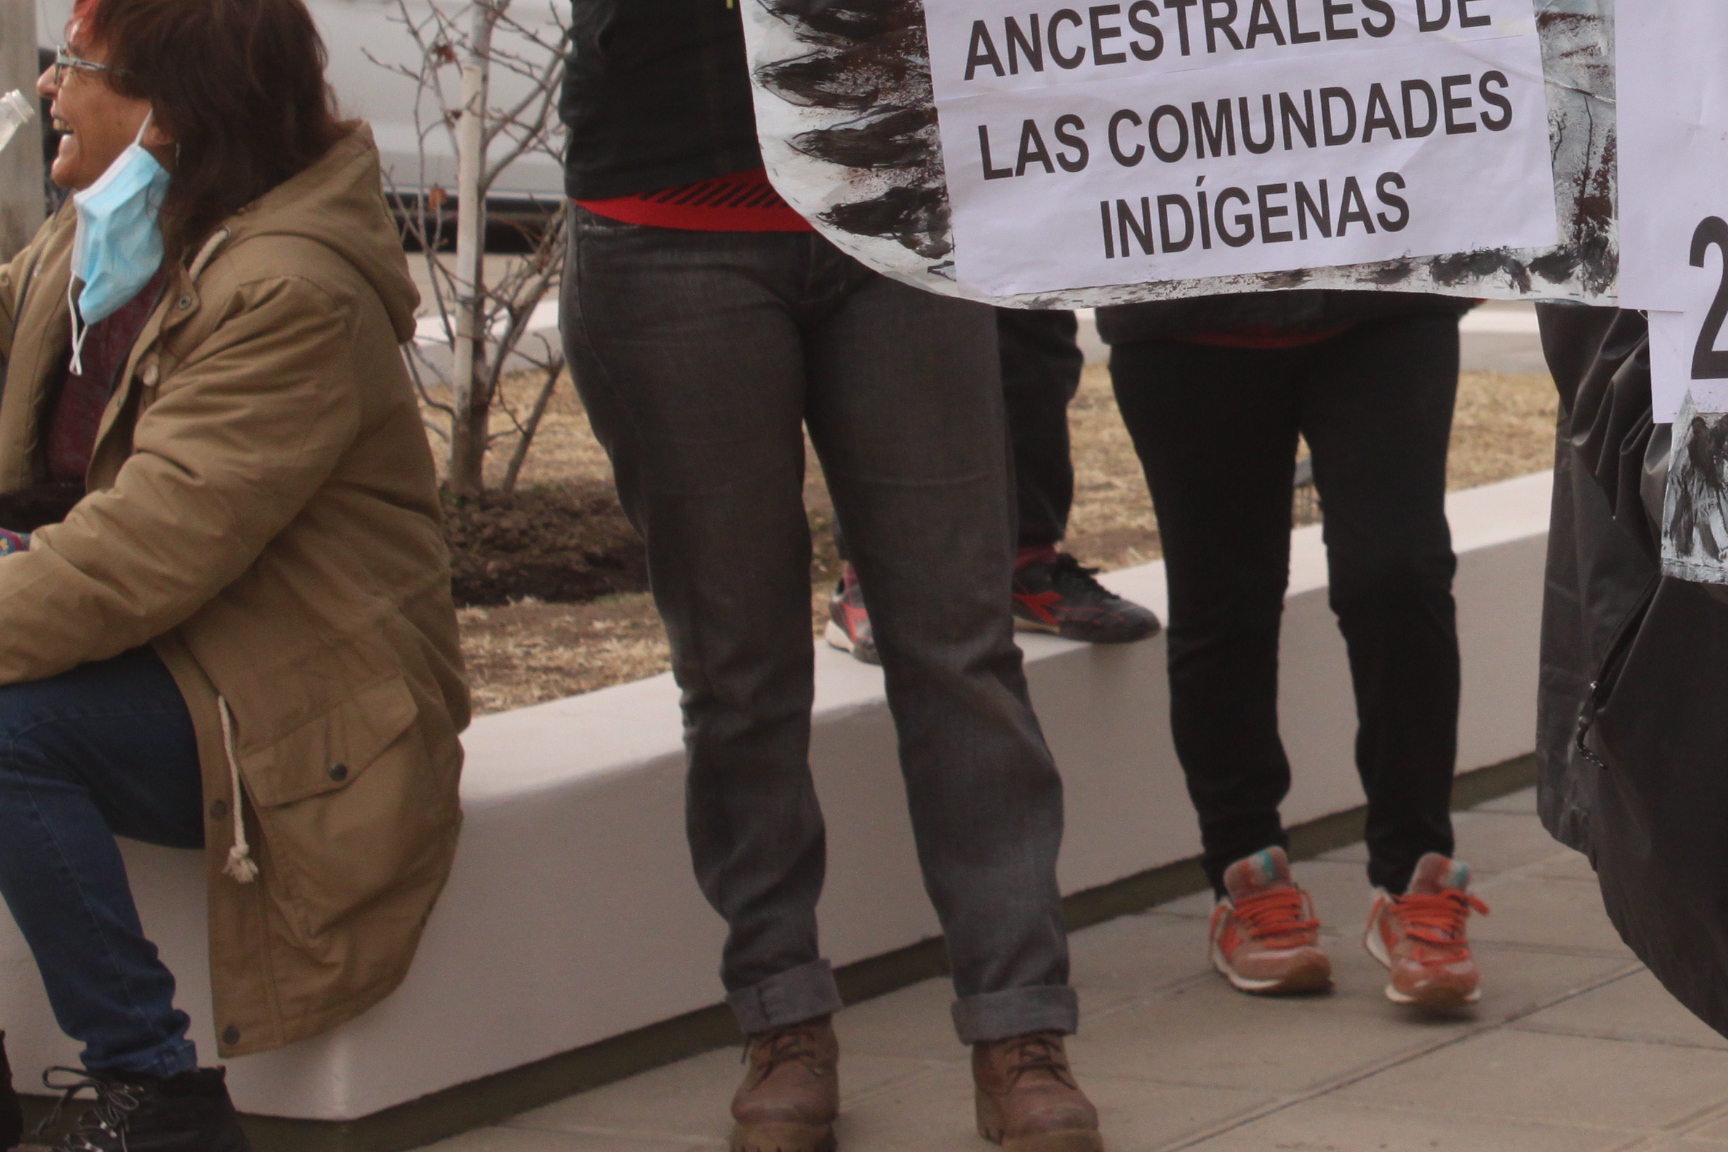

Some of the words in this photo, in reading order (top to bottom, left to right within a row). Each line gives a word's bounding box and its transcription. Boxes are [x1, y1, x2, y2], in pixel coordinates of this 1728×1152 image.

[977, 113, 1090, 181] LAS
[1107, 70, 1513, 168] COMUNDADES
[1100, 171, 1410, 259] INDÍGENAS
